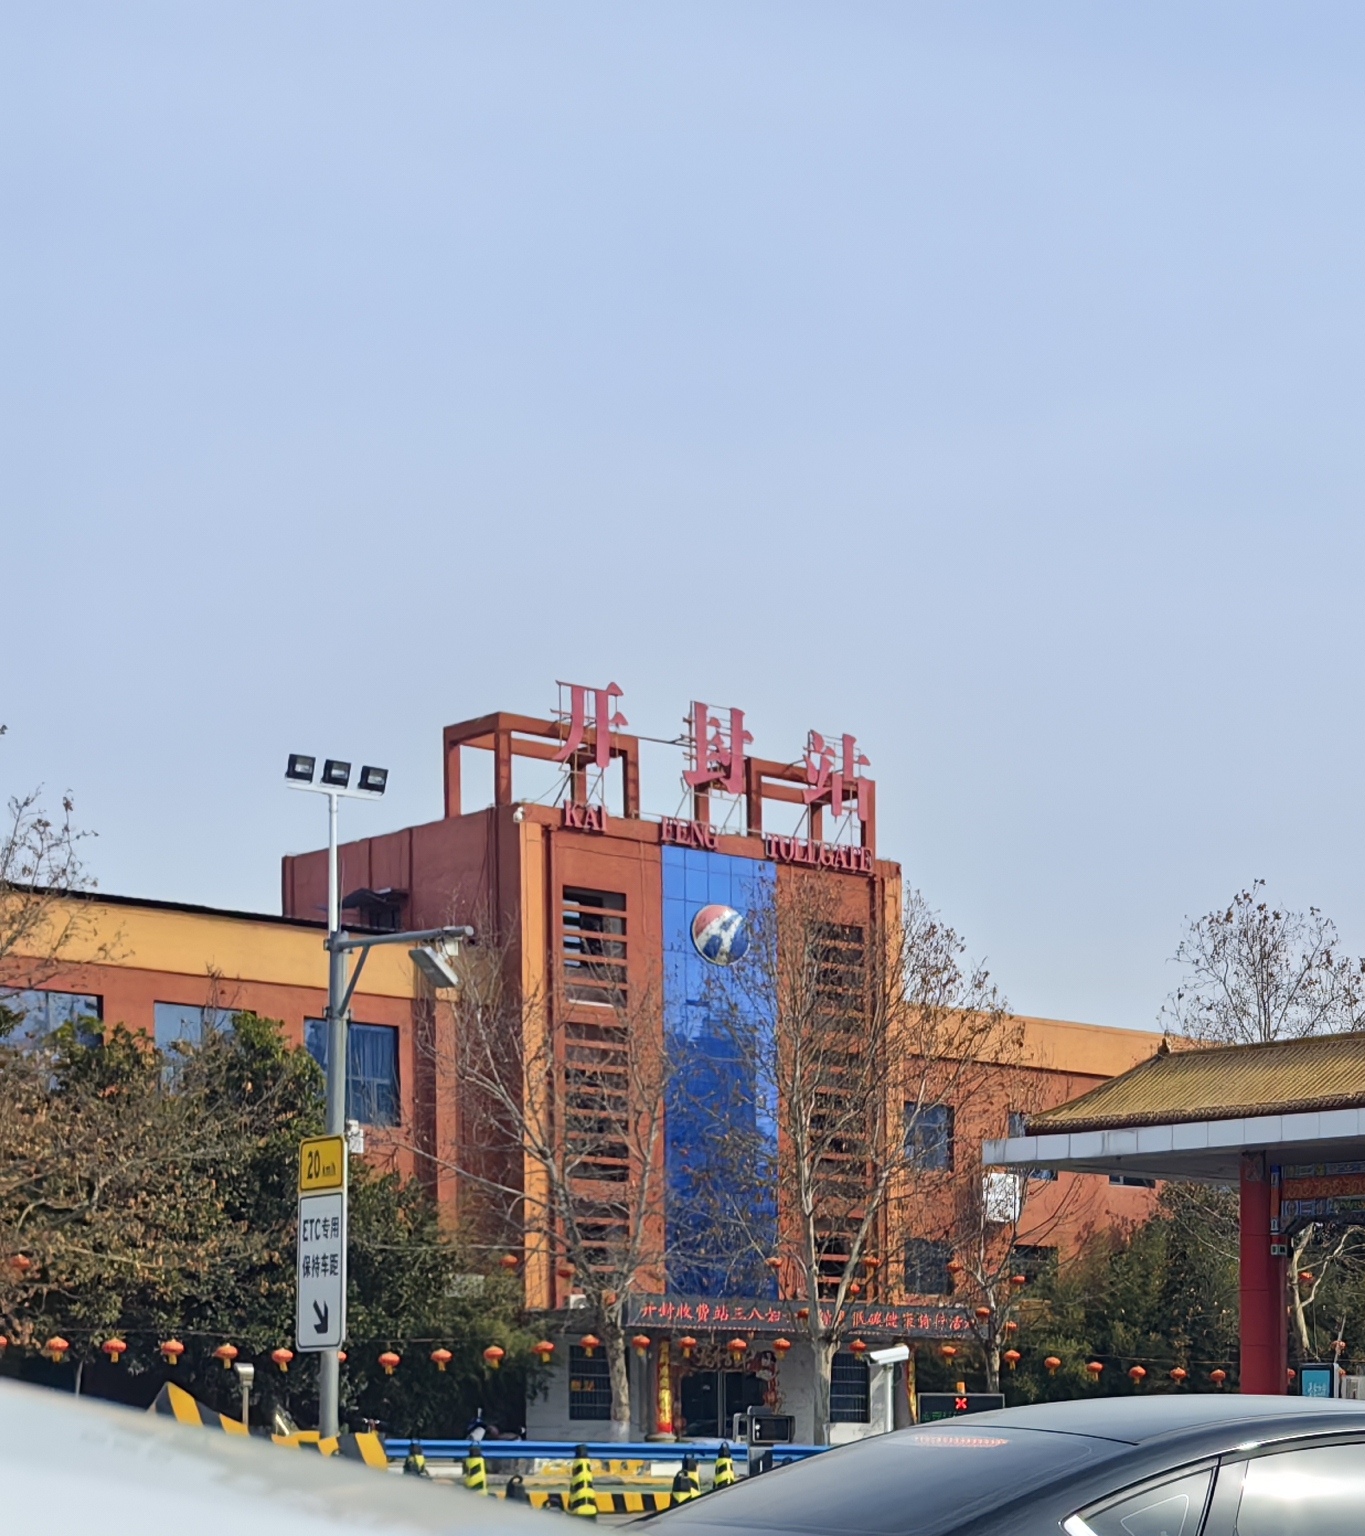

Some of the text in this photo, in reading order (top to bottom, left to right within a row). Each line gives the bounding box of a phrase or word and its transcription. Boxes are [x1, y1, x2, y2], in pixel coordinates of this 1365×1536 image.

[563, 799, 608, 832] KAI
[661, 816, 718, 849] FENG
[306, 1149, 321, 1180] 20
[302, 1217, 340, 1242] ETC专用
[302, 1253, 339, 1278] 保持车距
